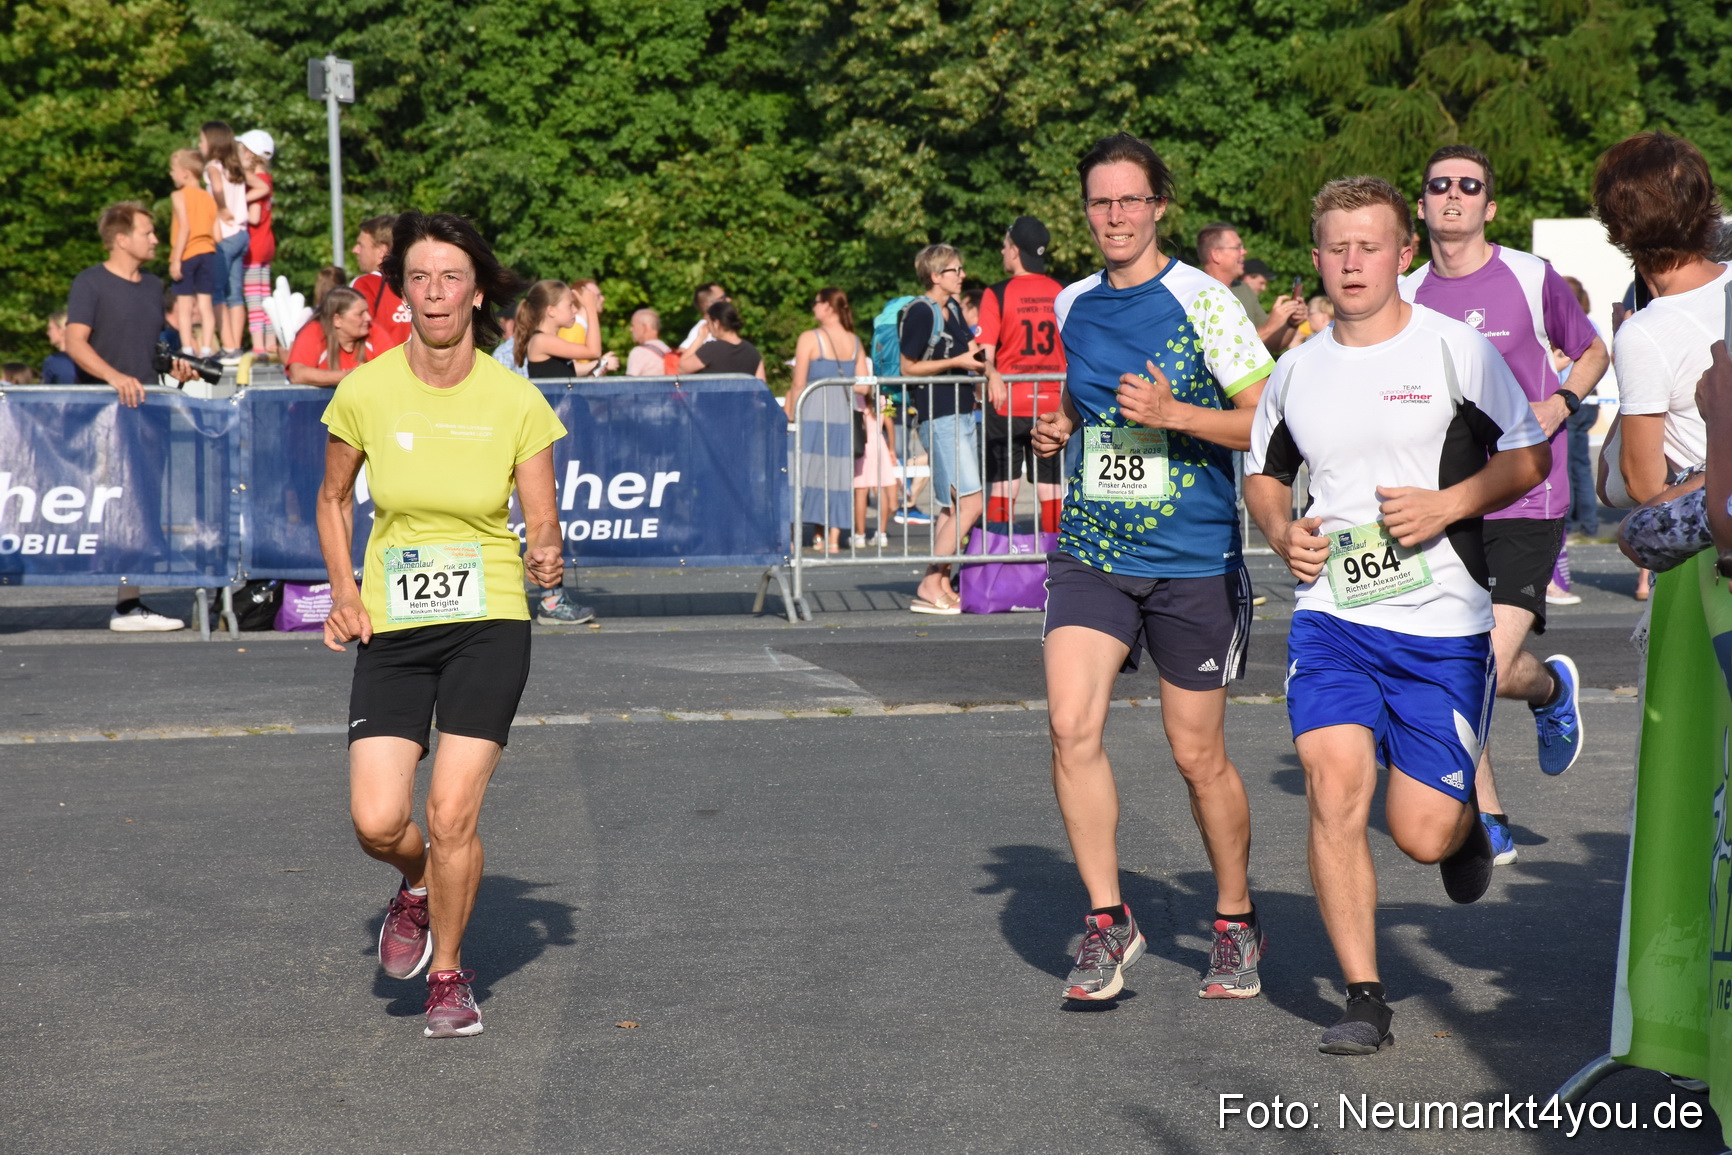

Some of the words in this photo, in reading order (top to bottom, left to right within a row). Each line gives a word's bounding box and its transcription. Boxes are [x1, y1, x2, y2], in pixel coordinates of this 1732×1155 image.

[1020, 319, 1055, 355] 13
[1390, 393, 1432, 401] partner
[1098, 454, 1145, 481] 258
[555, 460, 681, 510] her
[1343, 546, 1401, 584] 964
[396, 570, 470, 600] 1237
[1345, 583, 1371, 594] Richter
[1373, 571, 1412, 587] Alexander
[1346, 588, 1377, 601] guttenberger
[1378, 584, 1397, 592] partner
[1397, 577, 1415, 586] GmbH
[430, 600, 459, 608] Brigitte
[1441, 776, 1465, 790] adidas
